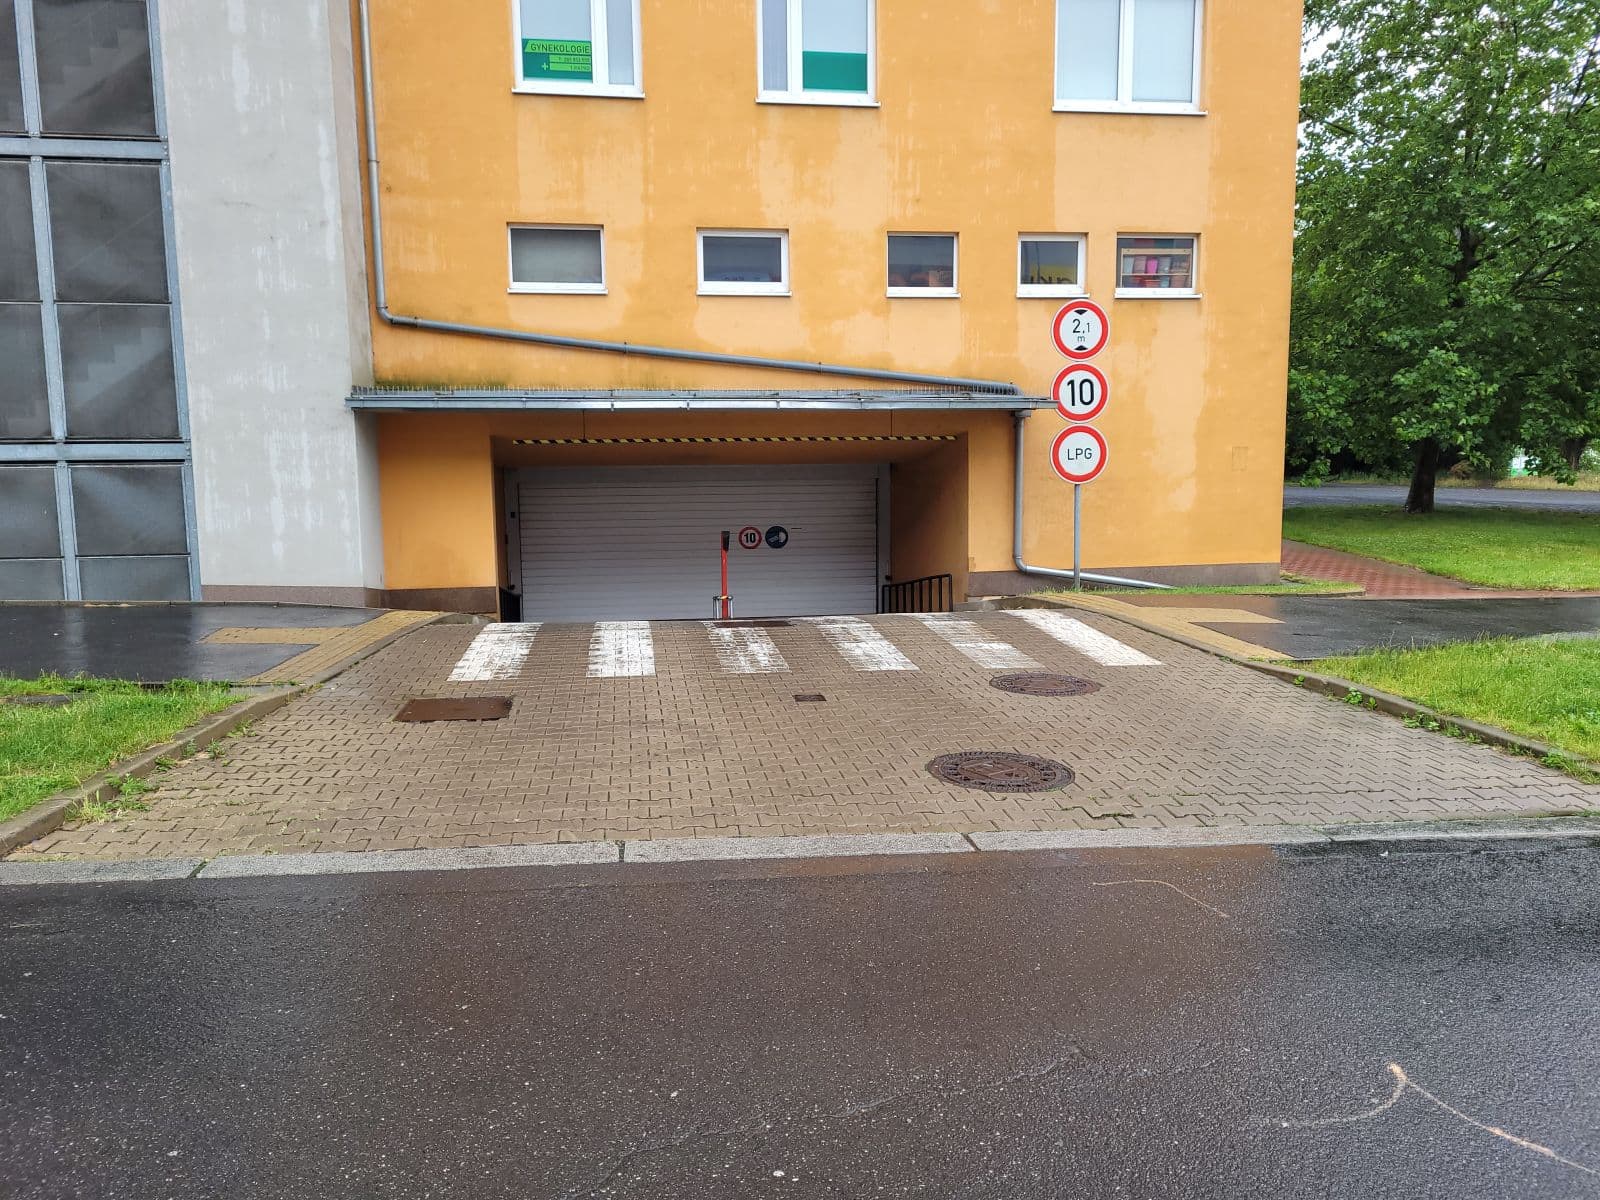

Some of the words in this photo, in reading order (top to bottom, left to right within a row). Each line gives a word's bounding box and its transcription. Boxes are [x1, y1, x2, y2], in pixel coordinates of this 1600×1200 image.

[530, 43, 590, 54] GYNEKOLOGIE
[1072, 318, 1090, 334] 2,1
[1067, 378, 1095, 406] 10
[1067, 448, 1092, 461] LPG
[744, 532, 756, 544] 10
